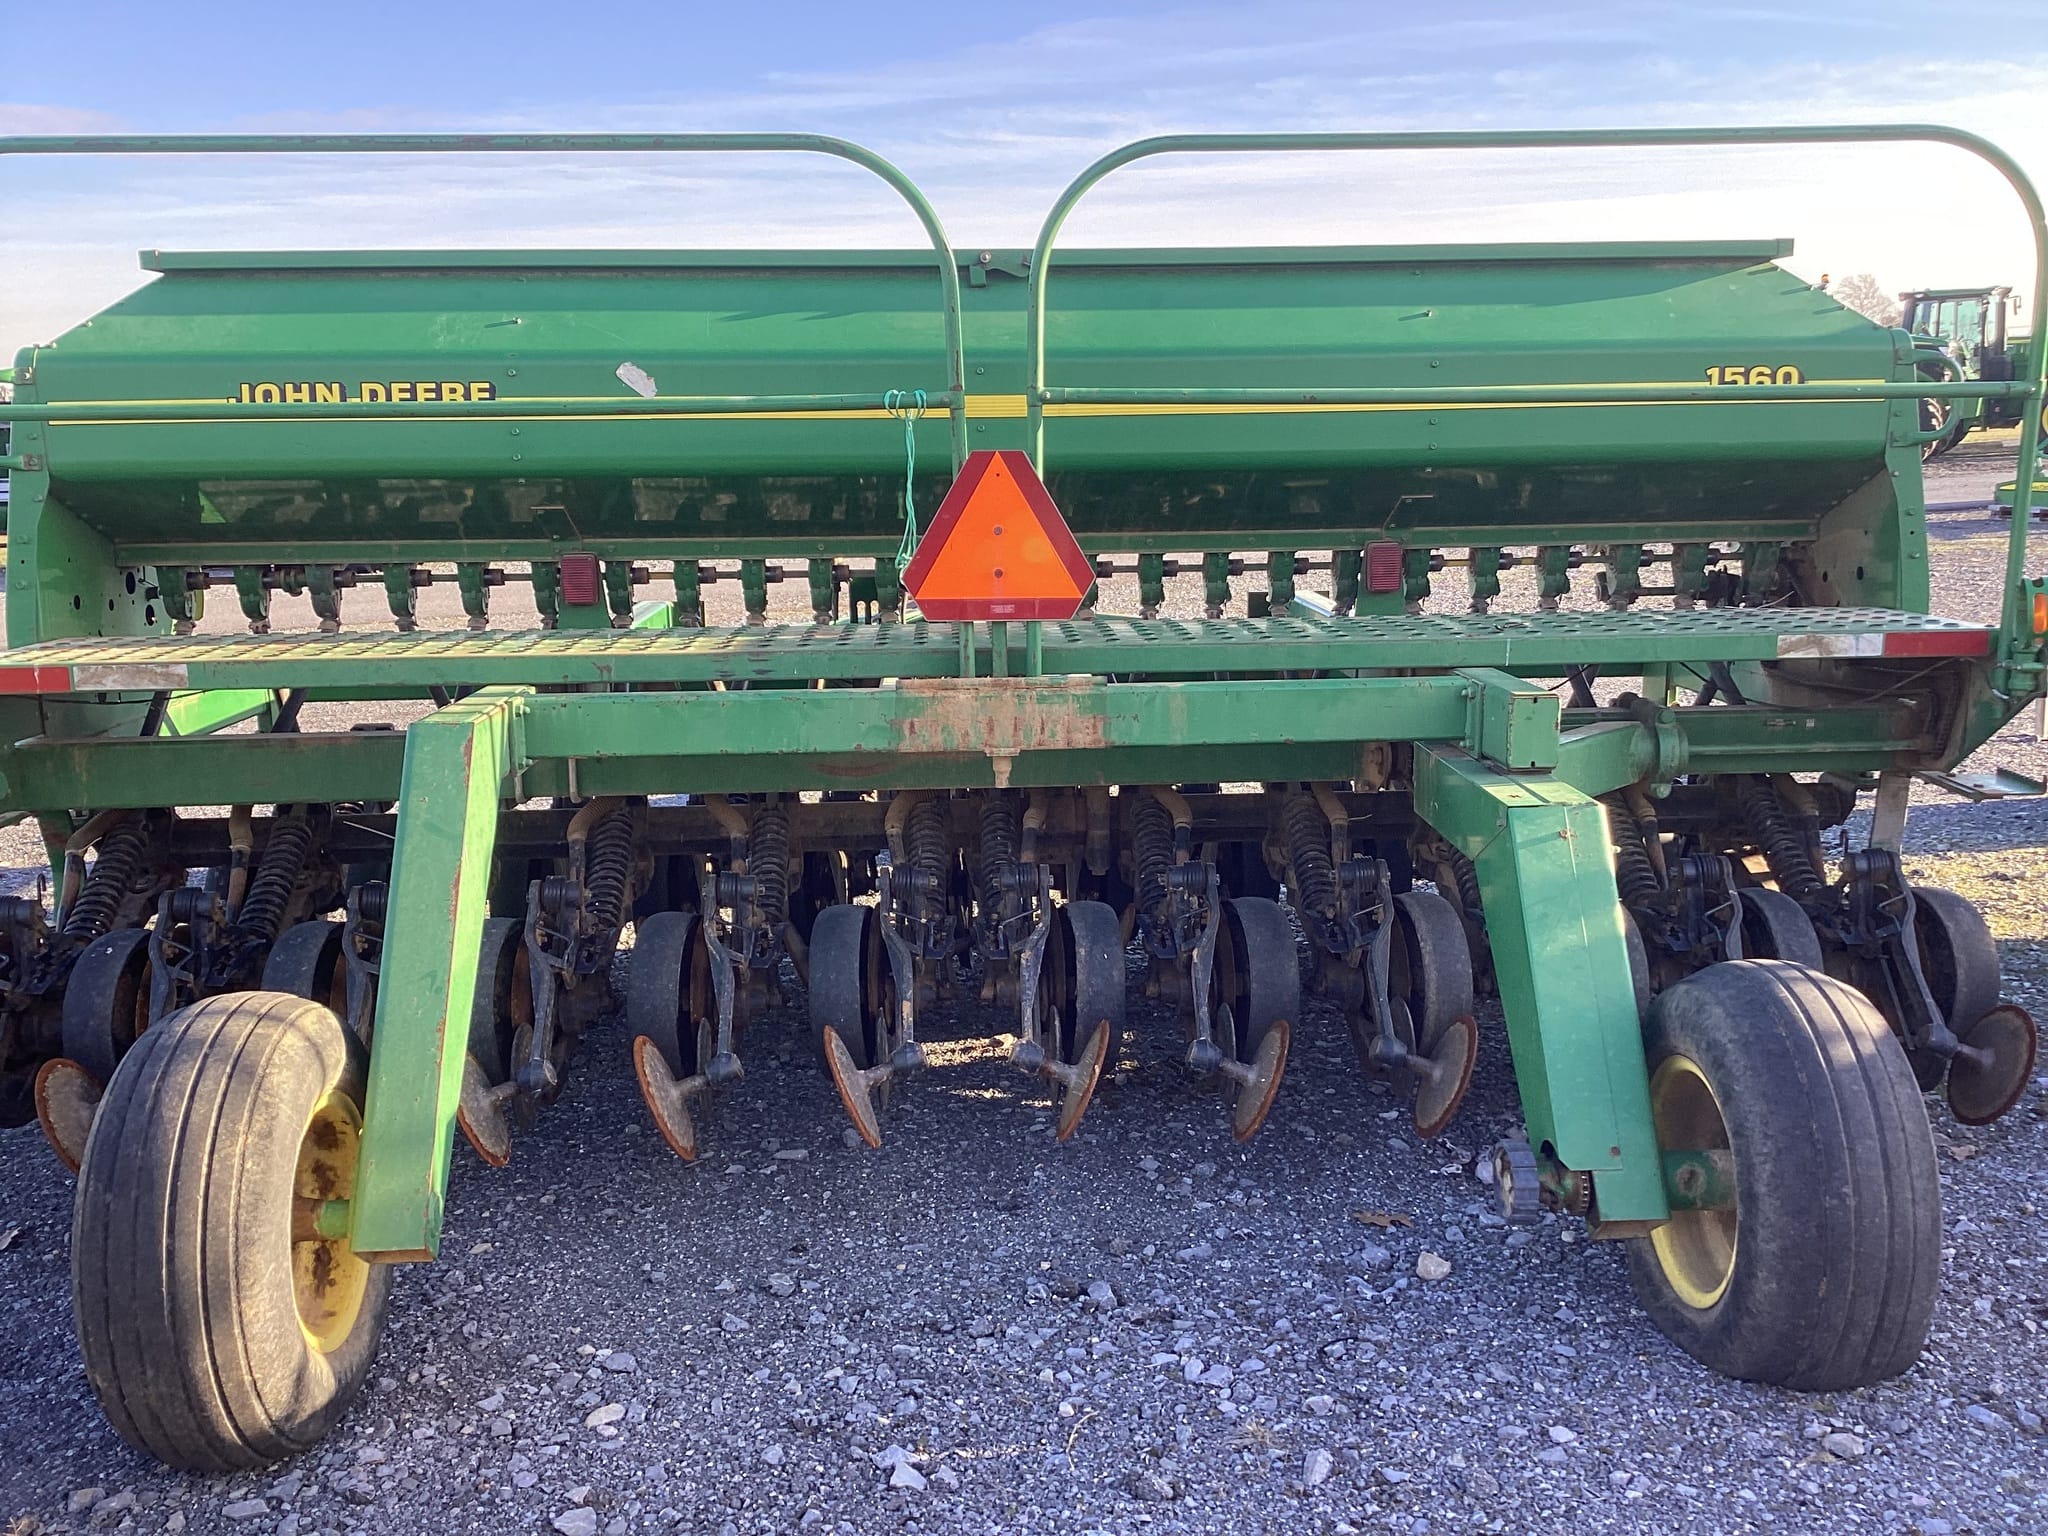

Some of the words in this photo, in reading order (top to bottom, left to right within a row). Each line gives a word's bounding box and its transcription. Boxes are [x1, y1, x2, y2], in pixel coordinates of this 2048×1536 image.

[1705, 365, 1803, 386] 1560
[227, 382, 345, 403] JOHN
[360, 382, 496, 402] DEERE
